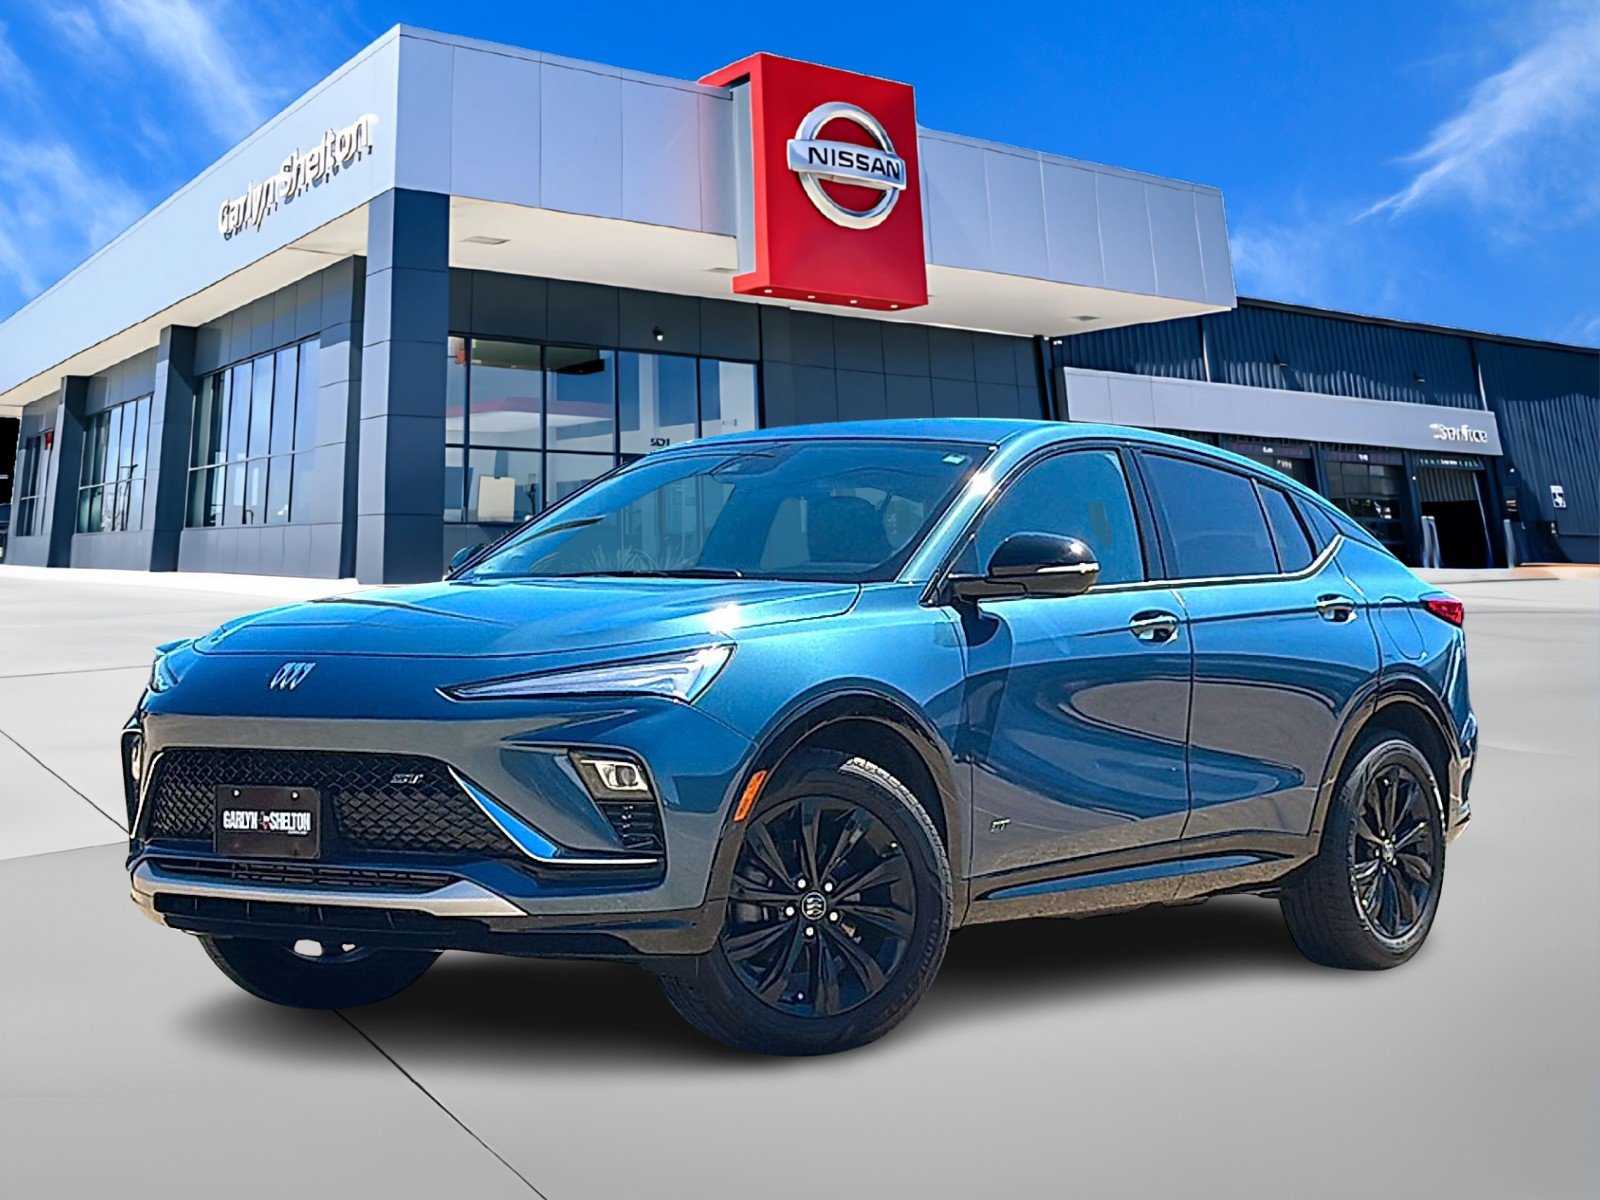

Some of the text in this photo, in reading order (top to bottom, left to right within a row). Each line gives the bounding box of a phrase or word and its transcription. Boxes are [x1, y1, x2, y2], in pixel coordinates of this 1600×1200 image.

[278, 114, 376, 204] Shelton
[808, 146, 900, 180] NISSAN
[223, 810, 311, 831] GARLYN SHELTON
